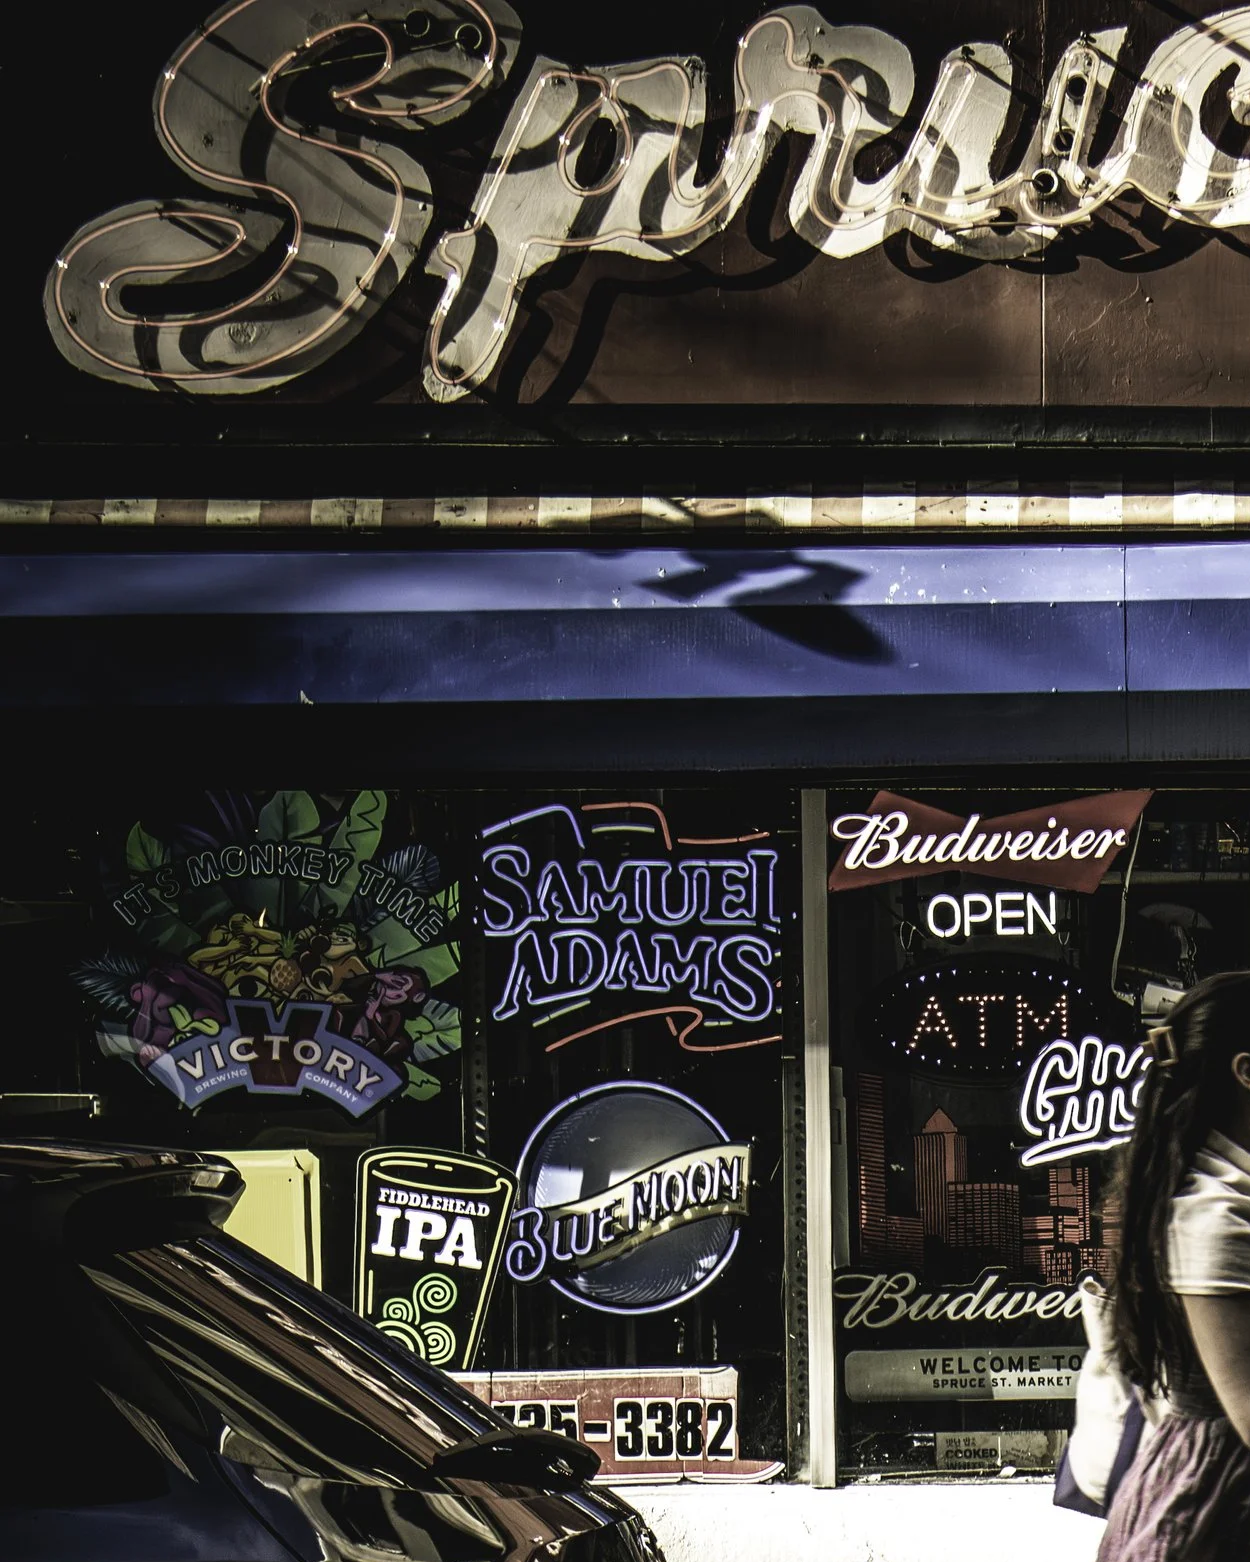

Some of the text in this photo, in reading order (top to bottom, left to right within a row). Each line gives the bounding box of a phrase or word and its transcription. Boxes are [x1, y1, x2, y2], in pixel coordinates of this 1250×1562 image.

[831, 811, 1127, 870] Budweiser
[186, 843, 352, 887] MONKEY
[360, 863, 444, 943] TIME
[482, 844, 781, 936] SAMUEL
[927, 890, 1057, 938] OPEN
[493, 929, 774, 1021] ADAMS
[908, 994, 1069, 1052] ATM
[176, 1034, 383, 1094] VICTORY
[194, 1067, 249, 1094] BREWING
[303, 1070, 360, 1103] COMPANY
[377, 1186, 491, 1218] FIDDLEHEAD
[631, 1155, 742, 1228] MOON
[371, 1205, 483, 1271] IPA
[505, 1206, 622, 1283] BLUE
[919, 1354, 1083, 1376] WELCOME TO
[932, 1375, 1073, 1389] SPRUCE ST. MARKET
[945, 1448, 998, 1459] COOKED
